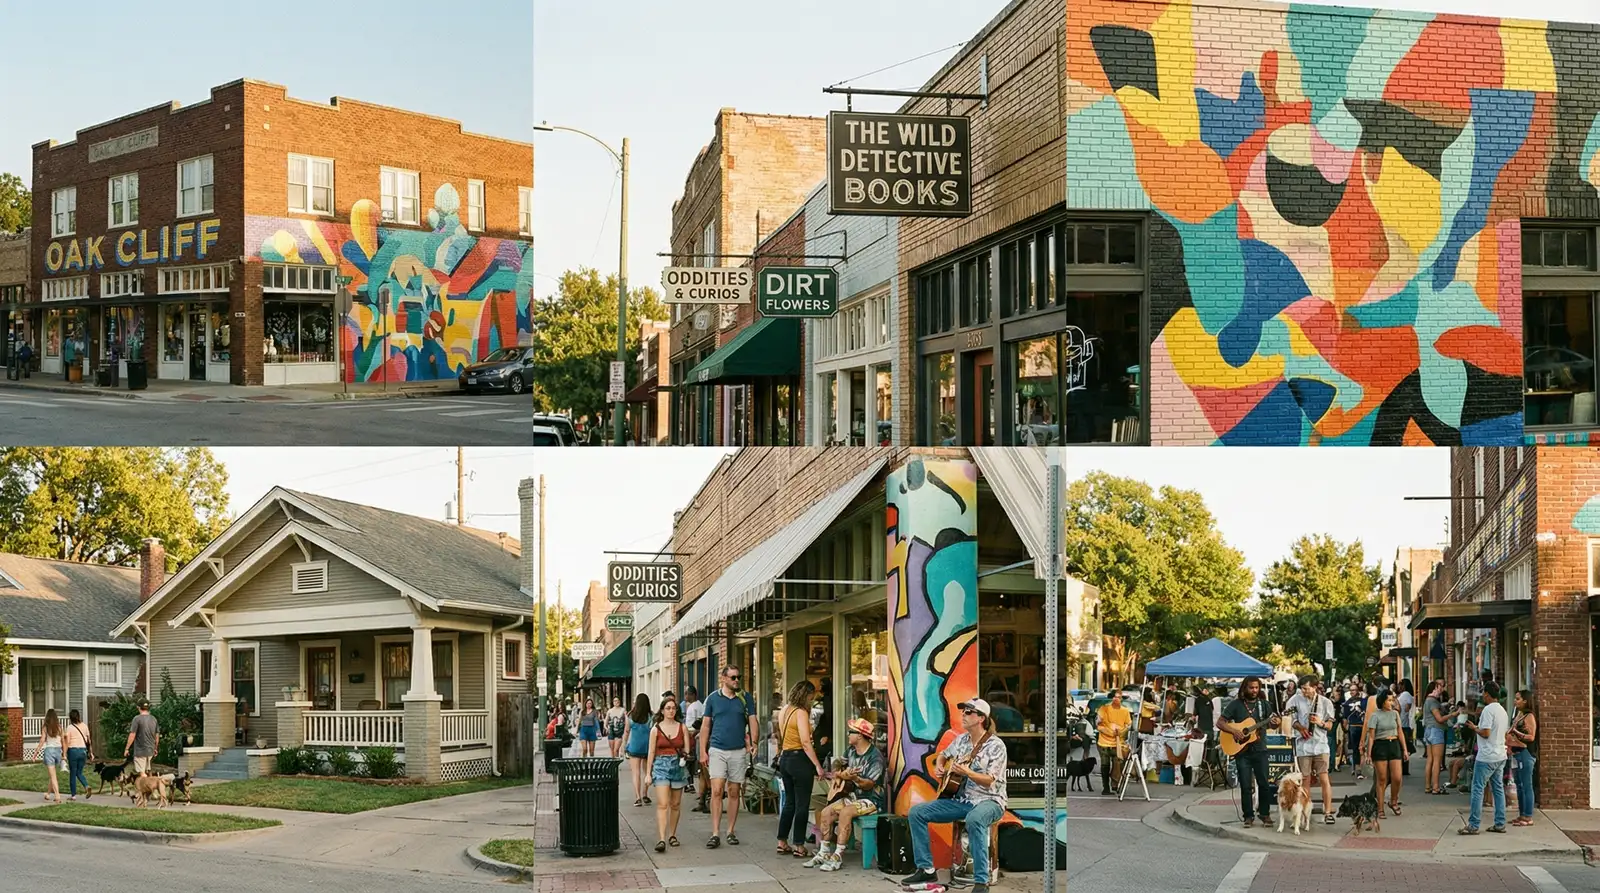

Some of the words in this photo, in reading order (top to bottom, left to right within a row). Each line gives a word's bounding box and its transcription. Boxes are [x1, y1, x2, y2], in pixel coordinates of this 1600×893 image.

[845, 120, 890, 144] THE
[897, 122, 957, 147] WILD
[841, 148, 962, 175] DETECTIVE
[845, 177, 959, 206] BOOKS
[45, 236, 105, 274] OAK
[115, 219, 221, 267] CLIFF
[667, 271, 748, 286] ODDITIES
[766, 273, 830, 296] DIRT
[675, 288, 684, 299] &
[689, 288, 740, 299] CURIOS
[766, 299, 830, 311] FLOWERS
[612, 566, 678, 581] ODDITIES
[612, 583, 622, 597] &
[626, 583, 678, 598] CURIOS
